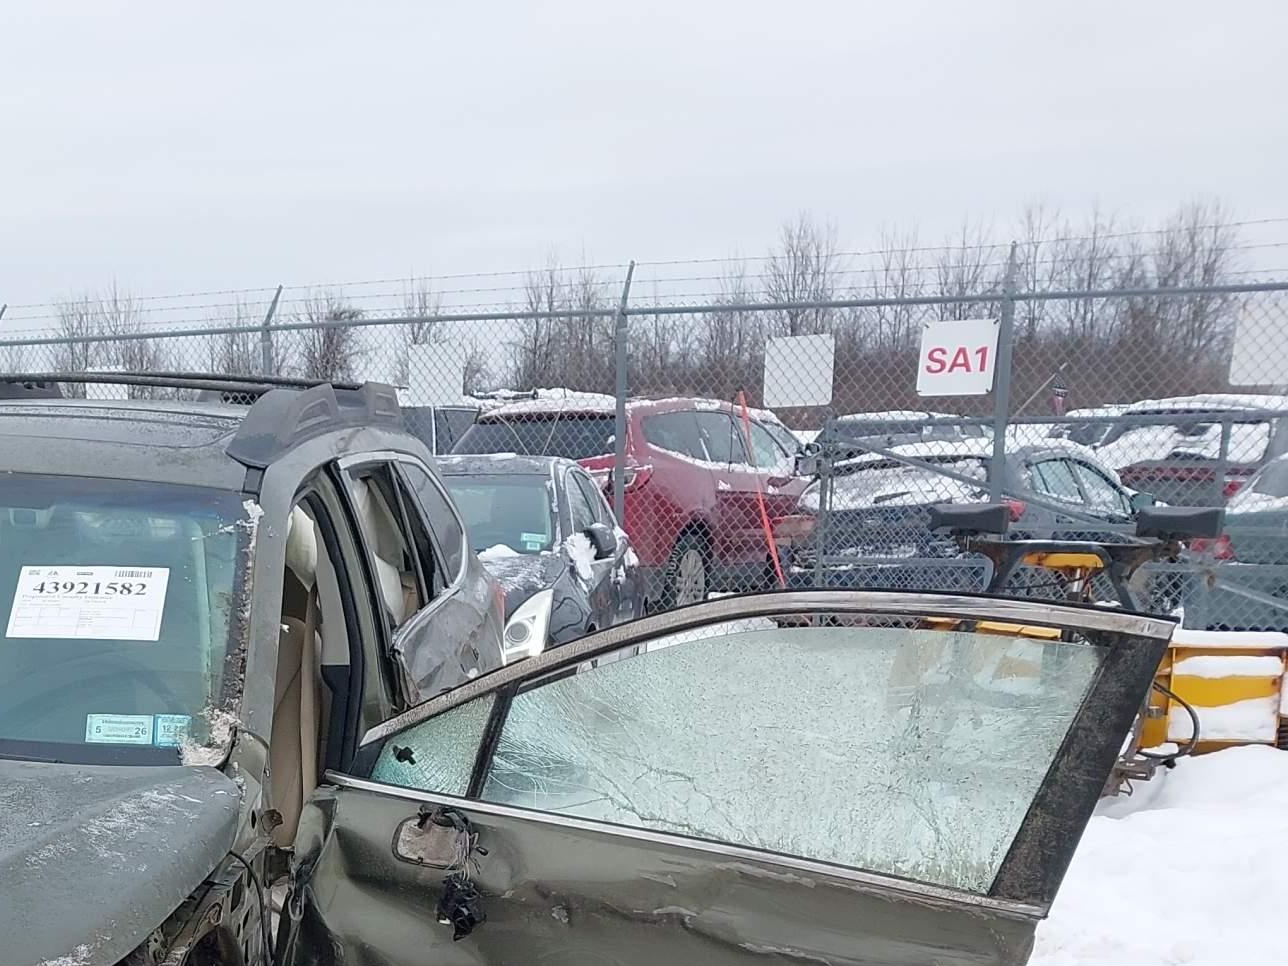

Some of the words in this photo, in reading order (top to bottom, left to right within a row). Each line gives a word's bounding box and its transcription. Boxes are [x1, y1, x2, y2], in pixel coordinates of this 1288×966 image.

[925, 346, 989, 374] SA1
[32, 581, 148, 596] 43921582
[95, 725, 102, 734] 5
[134, 727, 148, 736] 26
